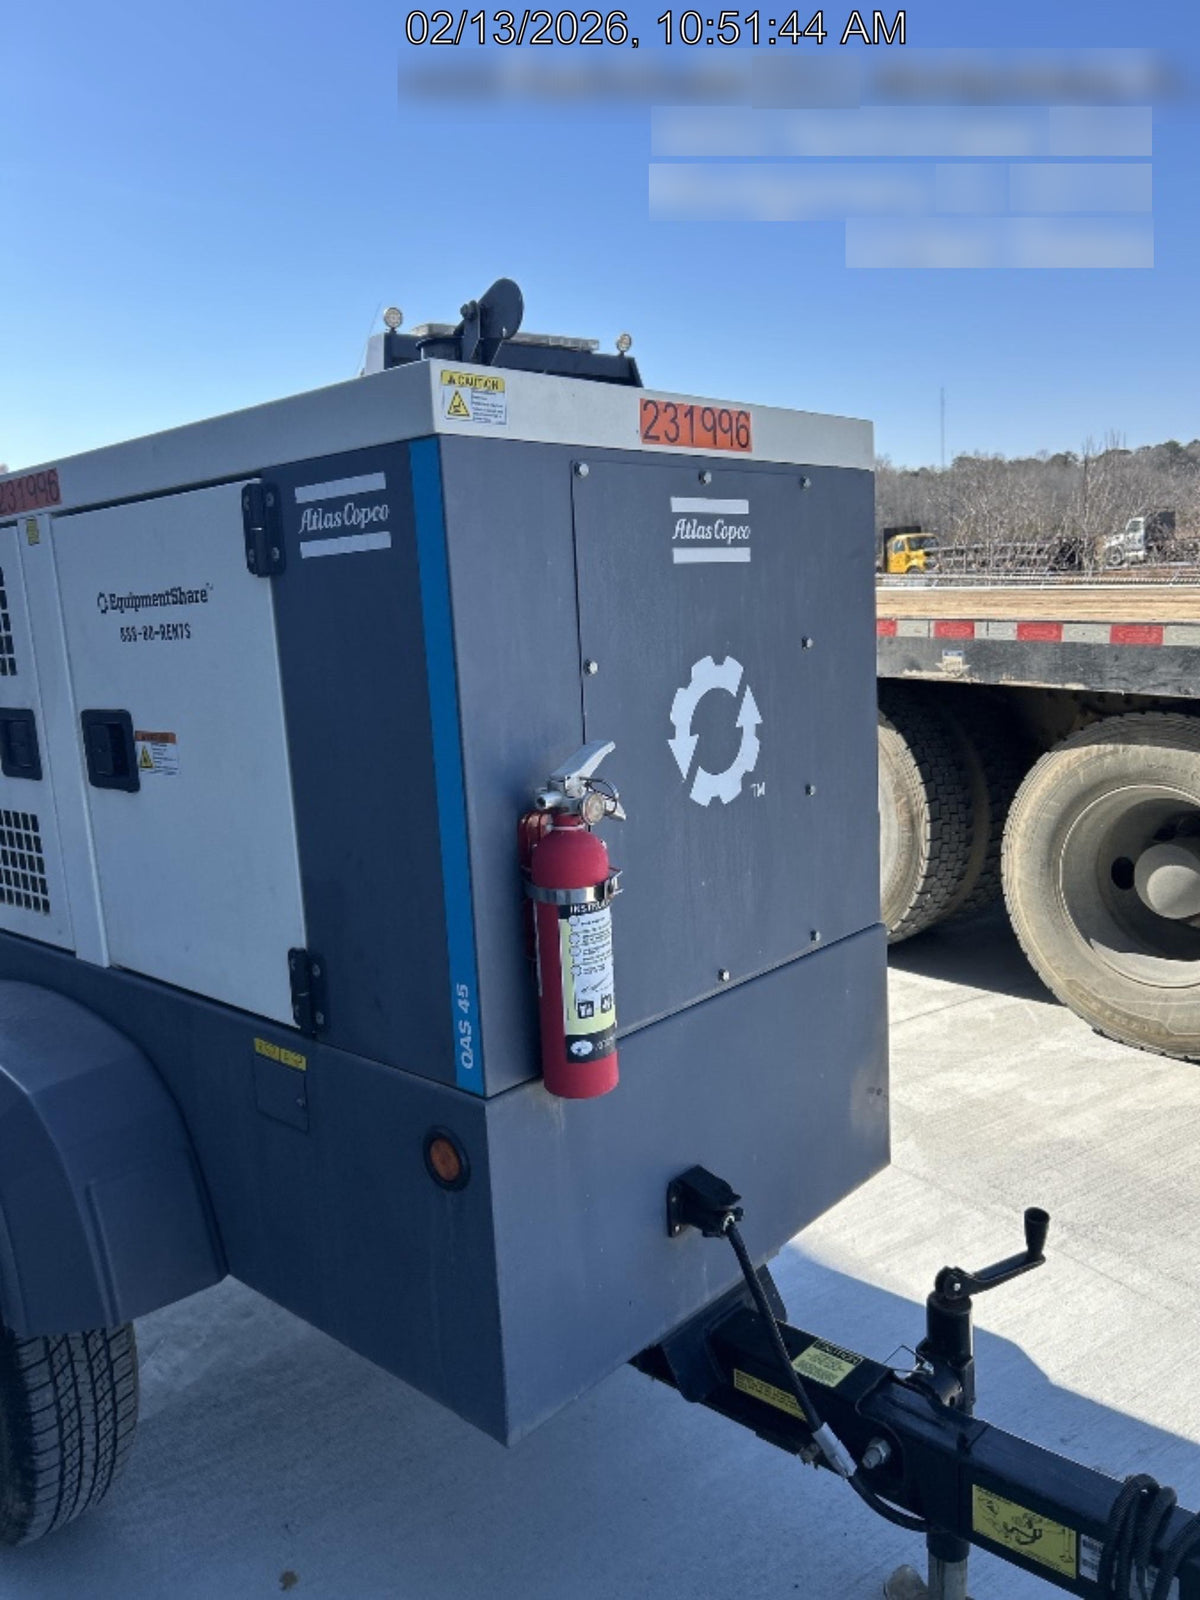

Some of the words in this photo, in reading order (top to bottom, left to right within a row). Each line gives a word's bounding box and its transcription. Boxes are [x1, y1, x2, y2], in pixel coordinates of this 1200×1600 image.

[643, 400, 750, 449] 231996
[298, 507, 342, 534] Atlas
[343, 502, 390, 529] Copco
[672, 519, 713, 540] Atlas
[714, 519, 751, 545] Copco
[109, 586, 209, 614] EquipmentShare
[456, 983, 470, 1014] 45
